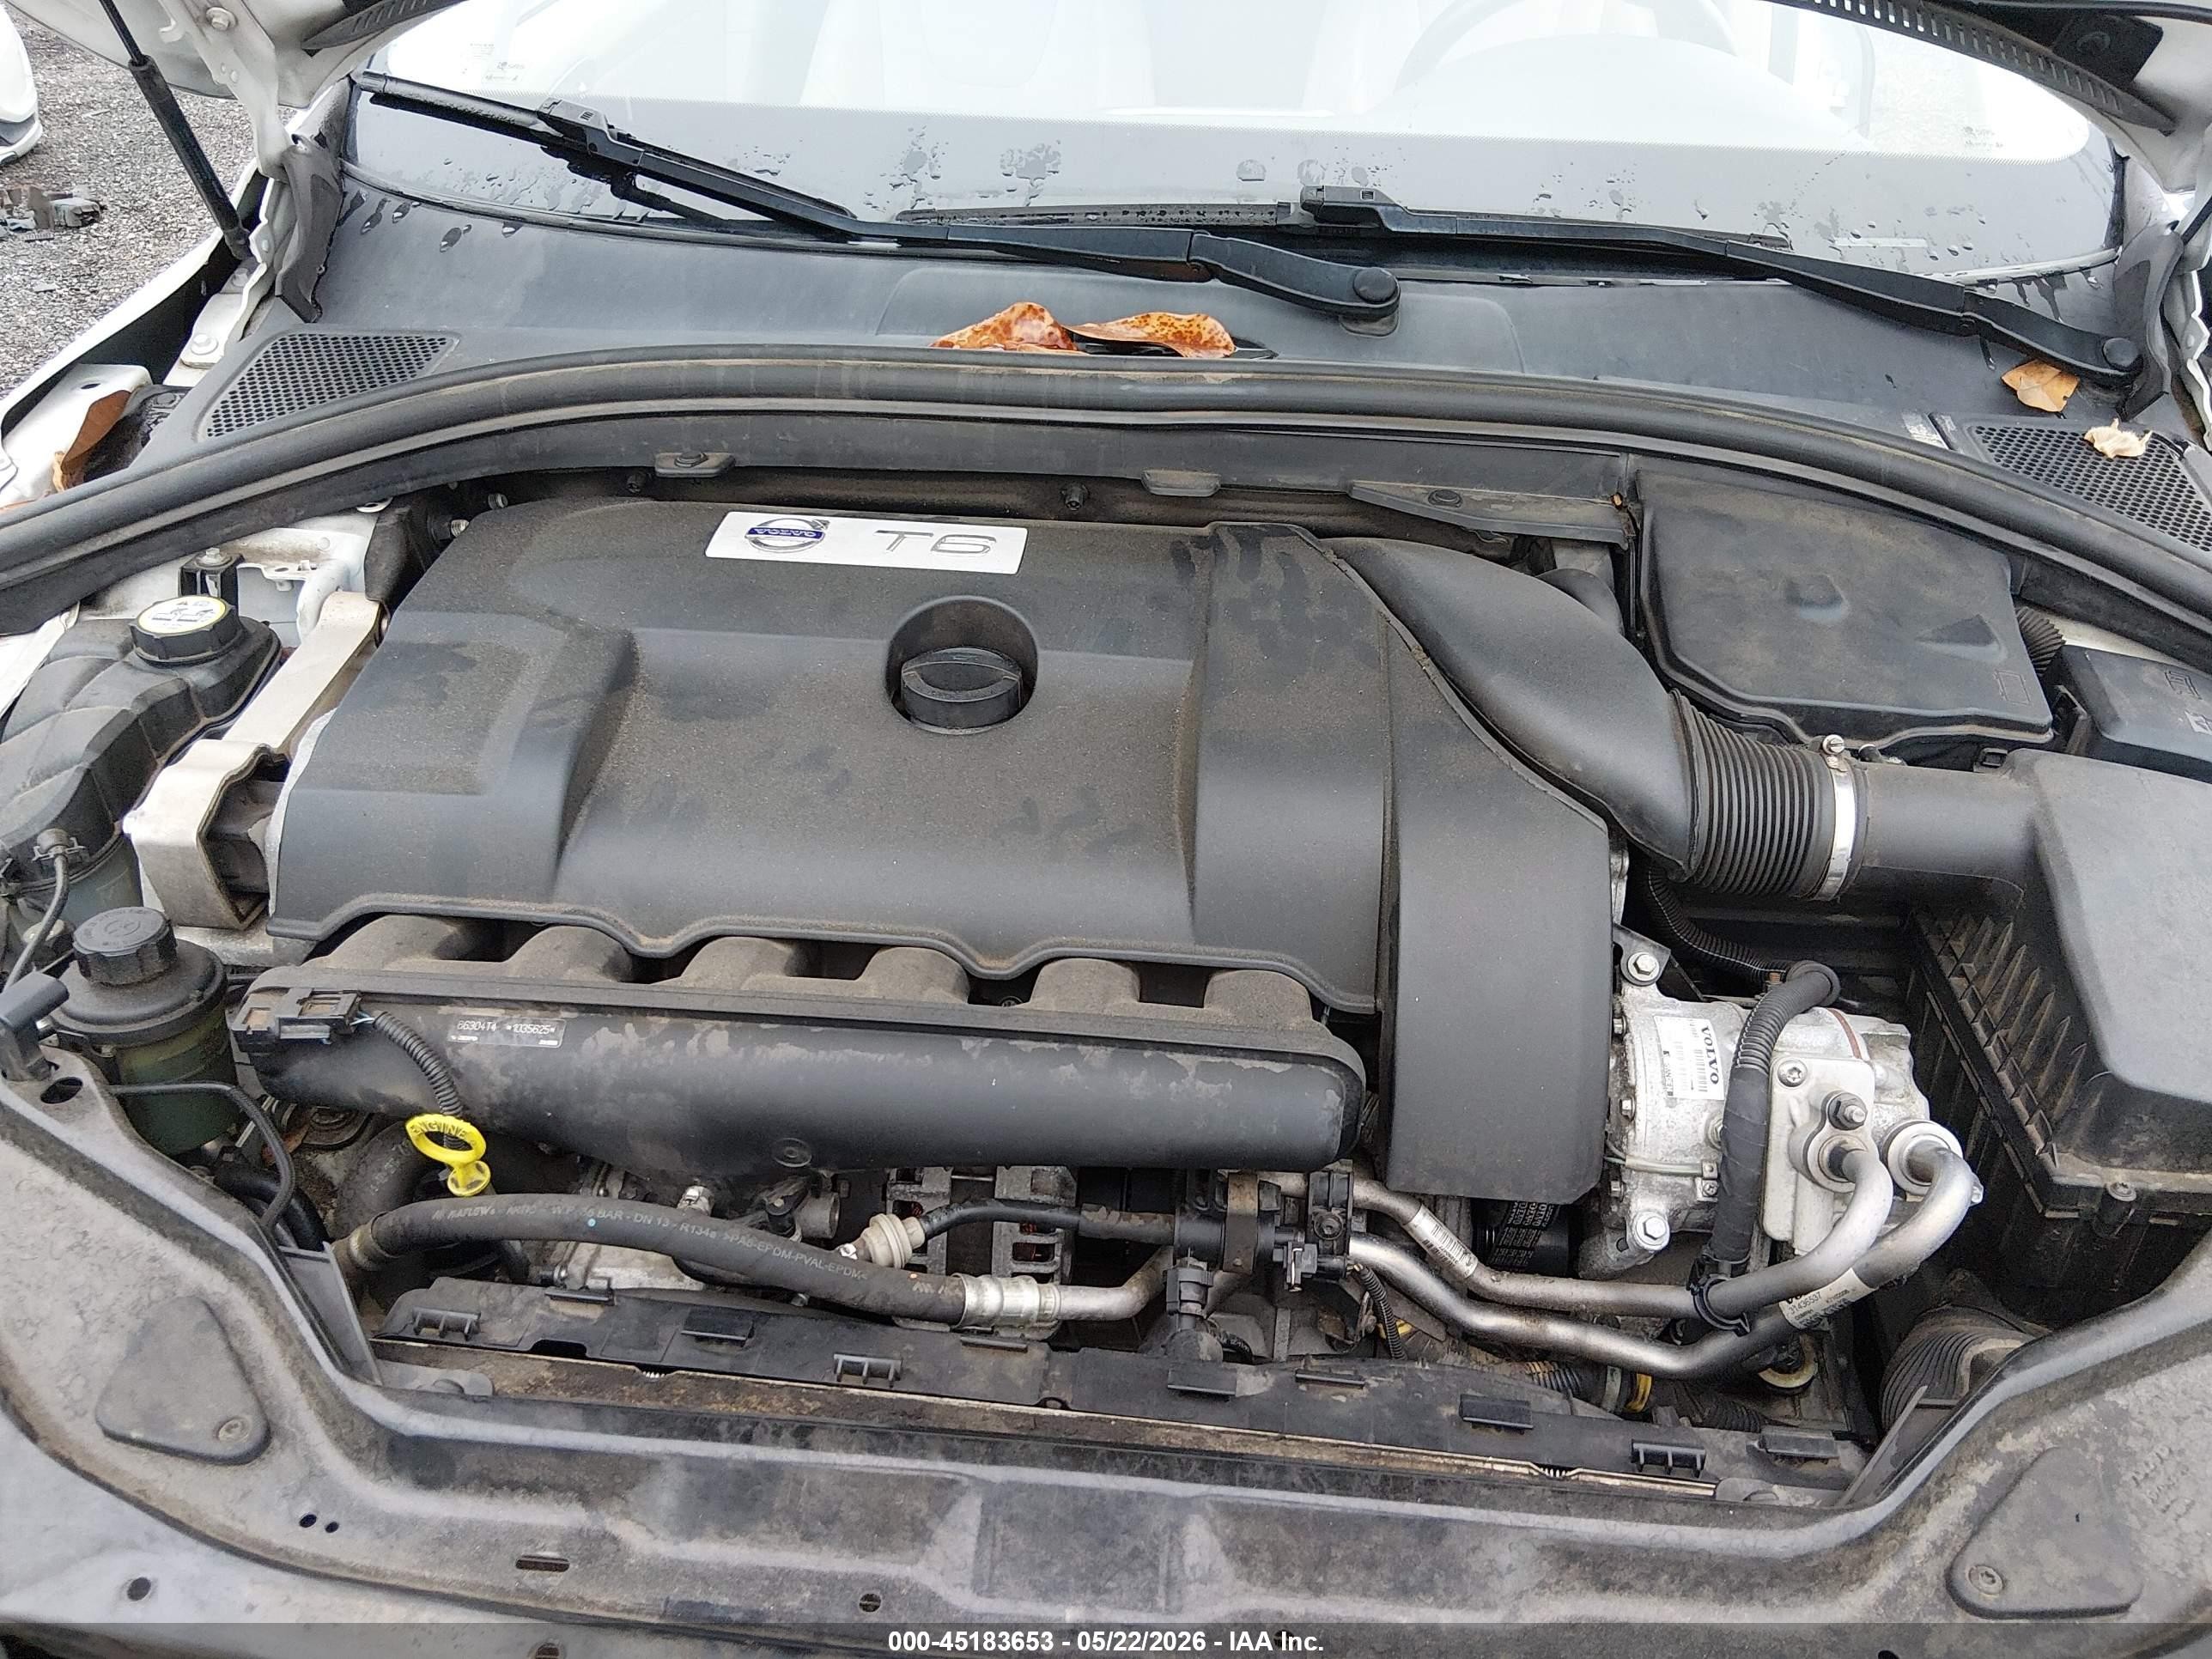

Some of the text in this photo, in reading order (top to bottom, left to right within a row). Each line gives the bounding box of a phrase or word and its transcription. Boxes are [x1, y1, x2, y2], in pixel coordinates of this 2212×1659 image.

[752, 527, 817, 538] VOLVO
[874, 529, 997, 554] T6
[1700, 1024, 1720, 1085] VOLVO
[410, 1120, 467, 1139] ENGINE
[633, 1212, 653, 1225] DN
